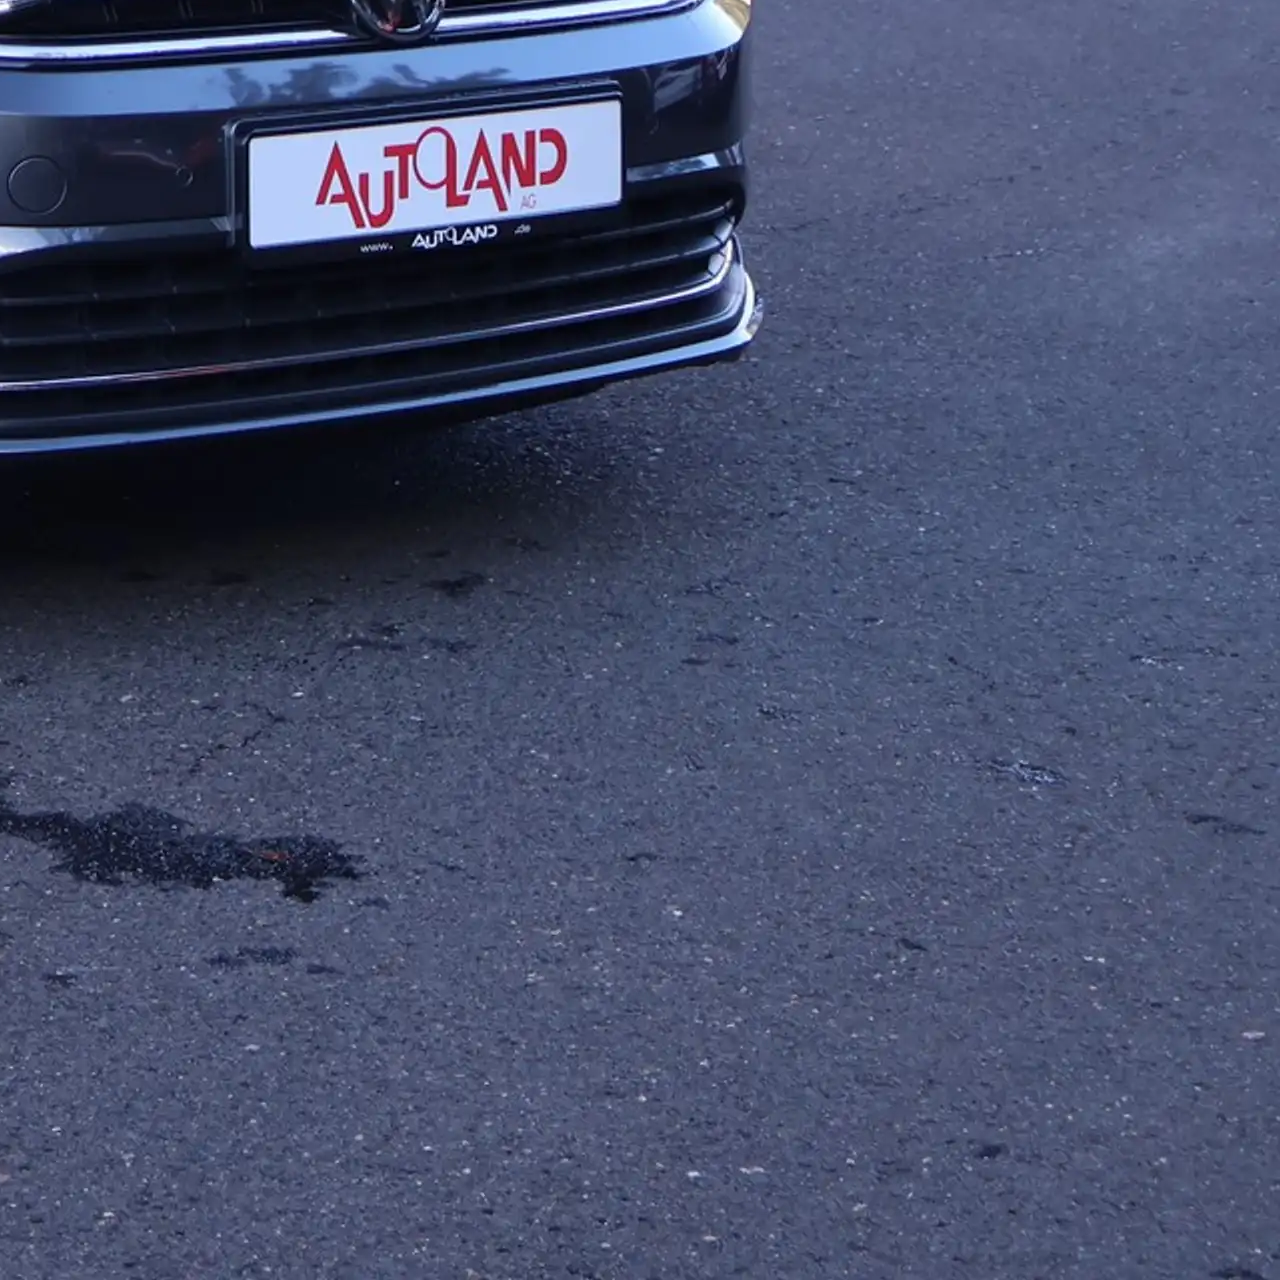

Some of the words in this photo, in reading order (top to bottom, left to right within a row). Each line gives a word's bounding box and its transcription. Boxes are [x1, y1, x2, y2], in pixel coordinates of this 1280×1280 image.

[316, 126, 568, 229] AUTOLAND
[519, 193, 537, 210] AG
[411, 224, 498, 250] AUTOLAND
